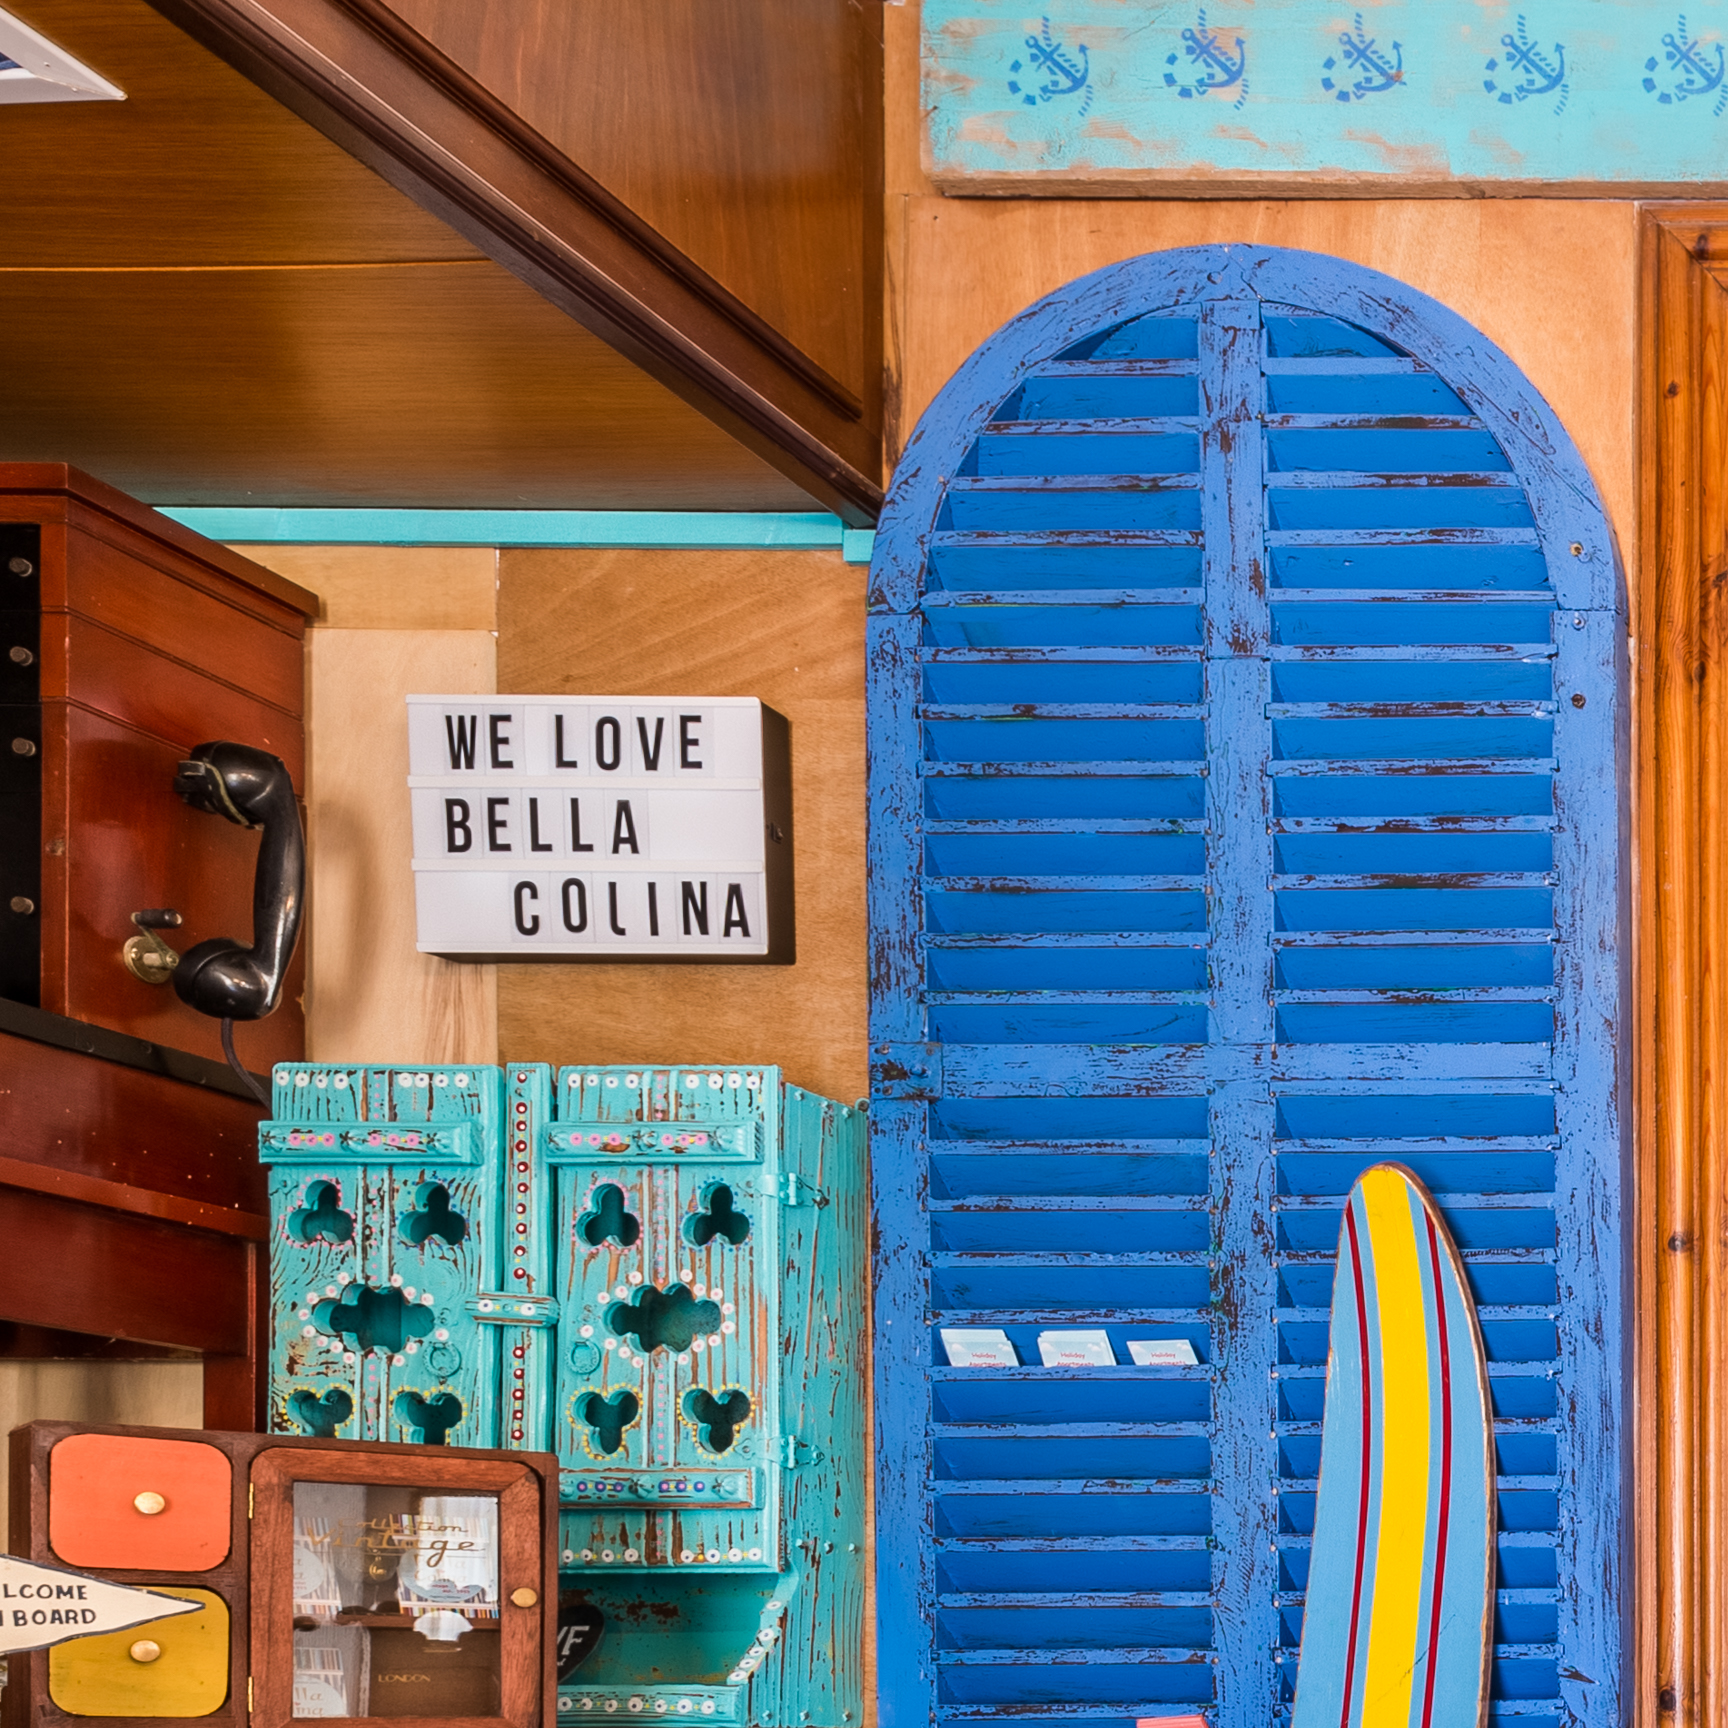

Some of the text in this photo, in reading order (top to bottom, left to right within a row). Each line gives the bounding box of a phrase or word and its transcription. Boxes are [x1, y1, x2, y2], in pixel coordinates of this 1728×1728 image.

[445, 713, 703, 771] WE LOVE
[444, 797, 640, 854] BELLA
[513, 877, 752, 938] COLINA
[306, 1525, 483, 1569] Vintage
[3, 1584, 88, 1600] LCOME
[13, 1609, 96, 1627] BOARD
[378, 1673, 431, 1683] LONDON
